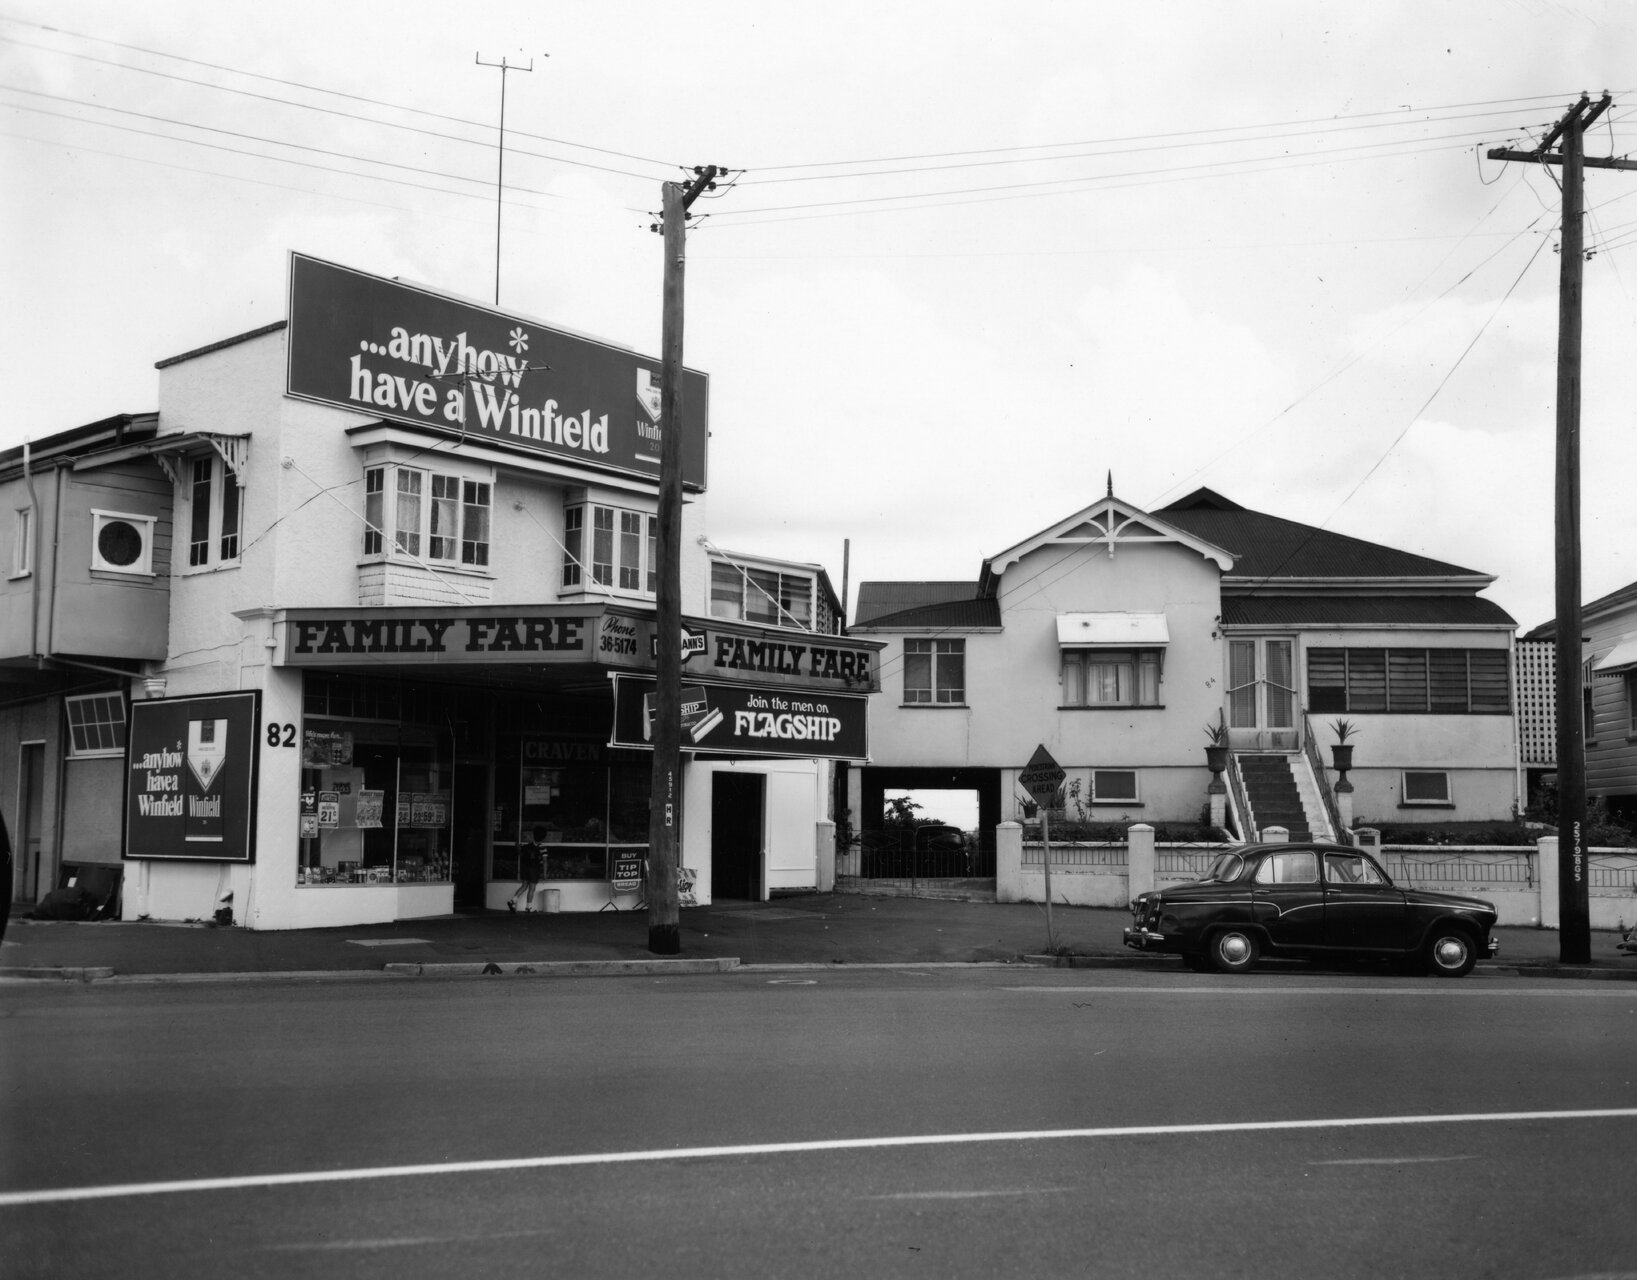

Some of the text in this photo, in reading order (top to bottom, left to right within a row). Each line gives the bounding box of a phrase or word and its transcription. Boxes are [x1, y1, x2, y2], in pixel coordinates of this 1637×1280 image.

[349, 354, 610, 454] have a Winfield
[637, 420, 662, 441] Winfi
[295, 618, 584, 654] FAMILY FARE
[602, 616, 637, 637] Phone
[600, 635, 638, 655] 36-5174
[681, 636, 705, 651] ANN'S
[714, 636, 870, 682] FAMILY FARE
[1205, 677, 1216, 689] 84
[681, 702, 700, 715] SHIP
[747, 694, 829, 714] Join the men on
[267, 722, 297, 748] 82
[734, 710, 842, 742] FLAGSHIP
[133, 747, 185, 774] ...anyhow
[525, 741, 600, 761] CRAVEN
[146, 770, 179, 792] have a
[1020, 771, 1063, 783] CROSSING
[1032, 783, 1055, 794] AHEAD
[138, 794, 184, 816] Winfield
[189, 794, 221, 817] Winfield
